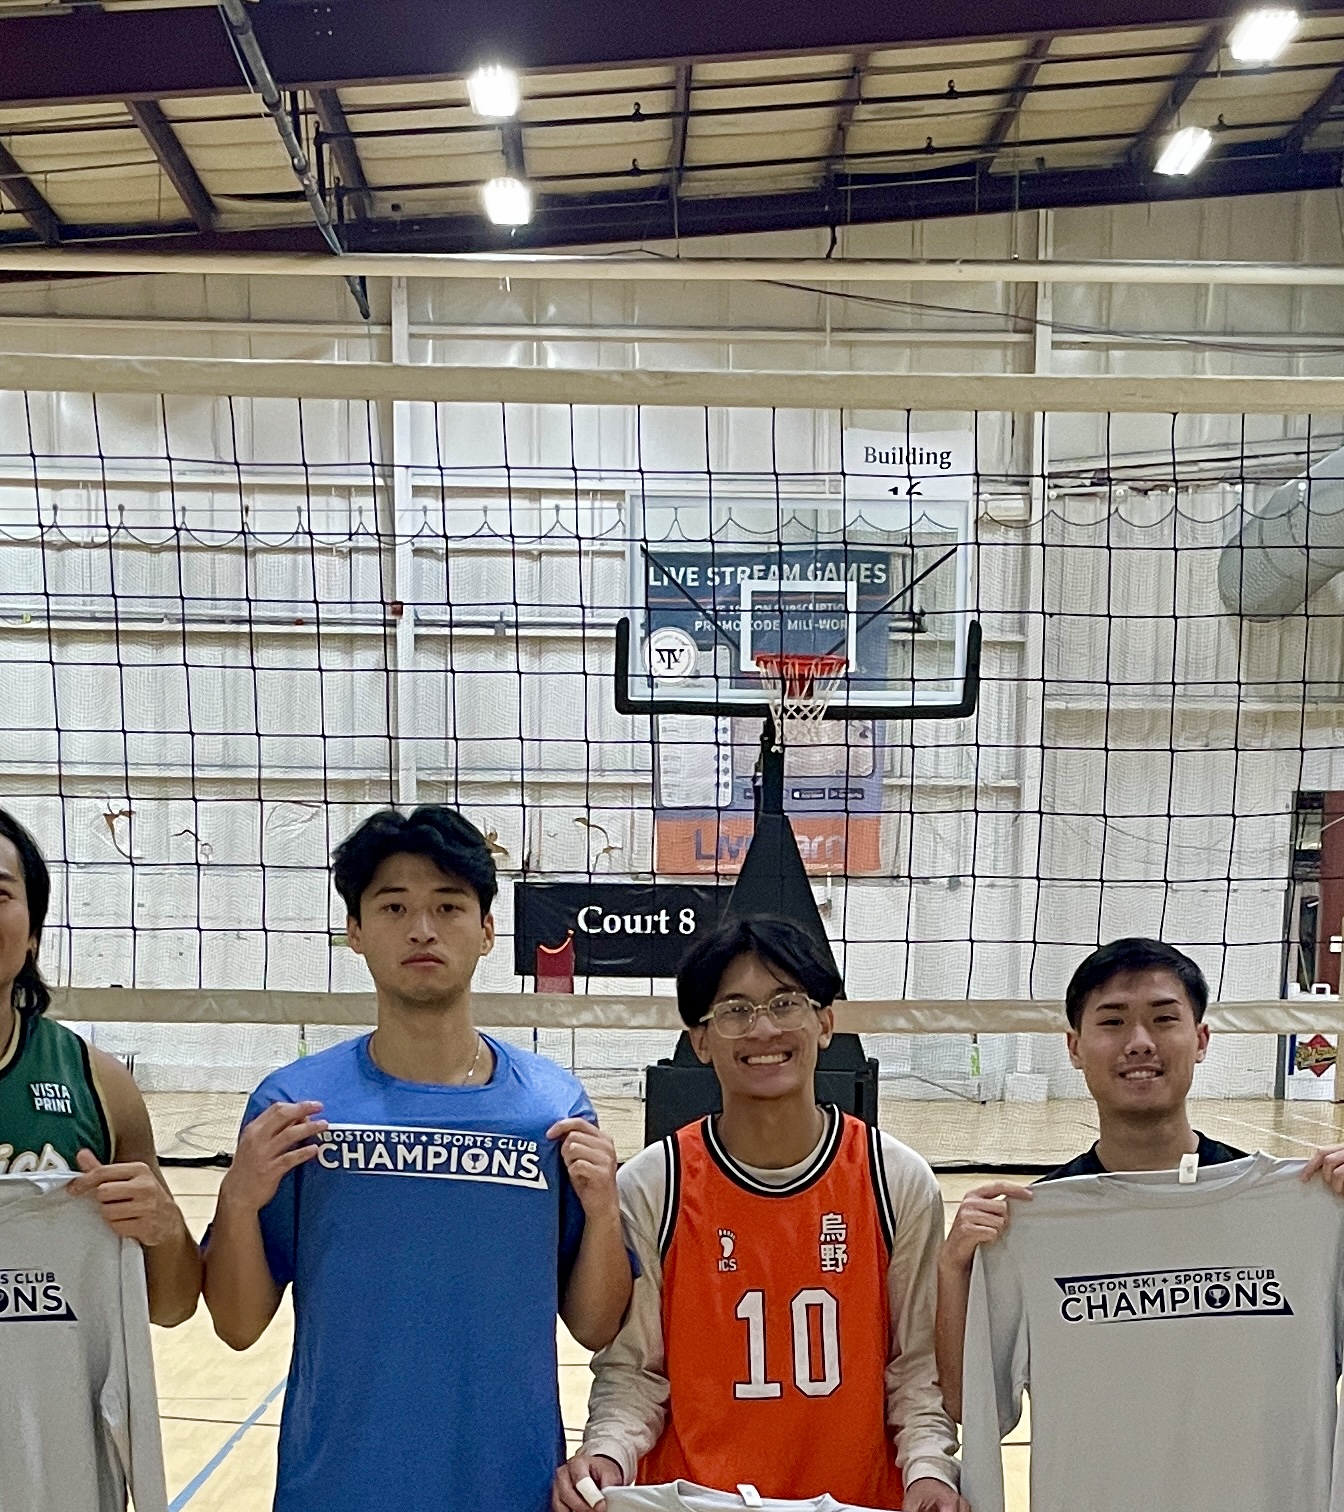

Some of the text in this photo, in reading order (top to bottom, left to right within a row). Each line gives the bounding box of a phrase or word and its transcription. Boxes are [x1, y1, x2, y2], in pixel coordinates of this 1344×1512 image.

[864, 446, 952, 470] Building
[649, 565, 699, 587] LIVE
[577, 905, 696, 934] Court 8
[30, 1082, 71, 1100] VISTA
[35, 1098, 72, 1114] PRINT
[324, 1131, 385, 1143] BOSTON
[390, 1132, 414, 1143] SKI
[434, 1134, 492, 1148] SPORTS
[498, 1138, 537, 1152] CLUB
[318, 1142, 540, 1178] CHAMPIONS
[14, 1272, 56, 1284] CLUB
[1068, 1280, 1127, 1295] BOSTON
[1132, 1277, 1156, 1289] SKI
[1174, 1271, 1231, 1285] SPORTS
[1237, 1269, 1276, 1281] CLUB
[1061, 1281, 1281, 1322] CHAMPIONS
[734, 1288, 842, 1400] 10
